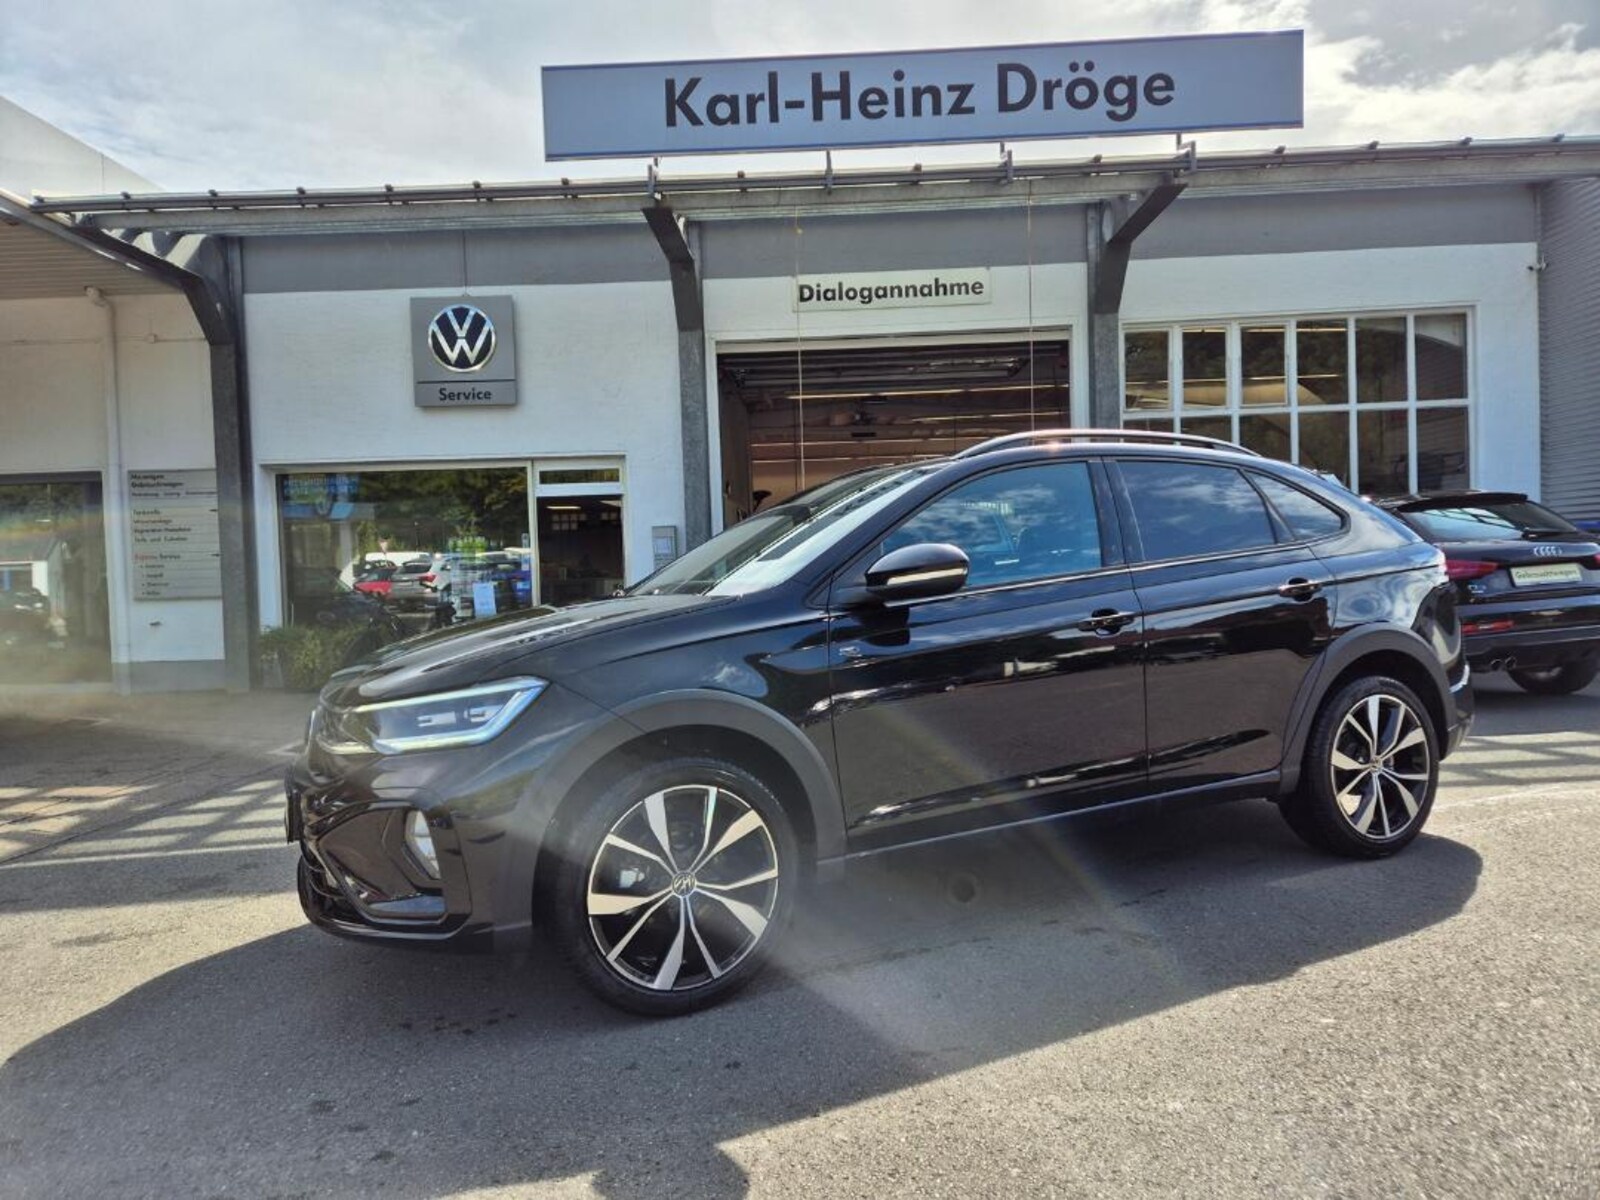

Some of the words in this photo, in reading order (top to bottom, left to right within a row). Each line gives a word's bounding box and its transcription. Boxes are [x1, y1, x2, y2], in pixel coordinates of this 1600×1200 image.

[664, 69, 977, 128] Karl-Heinz
[997, 60, 1175, 121] Dröge
[798, 277, 984, 304] Dialogannahme
[429, 304, 495, 371] VW
[439, 388, 492, 401] Service
